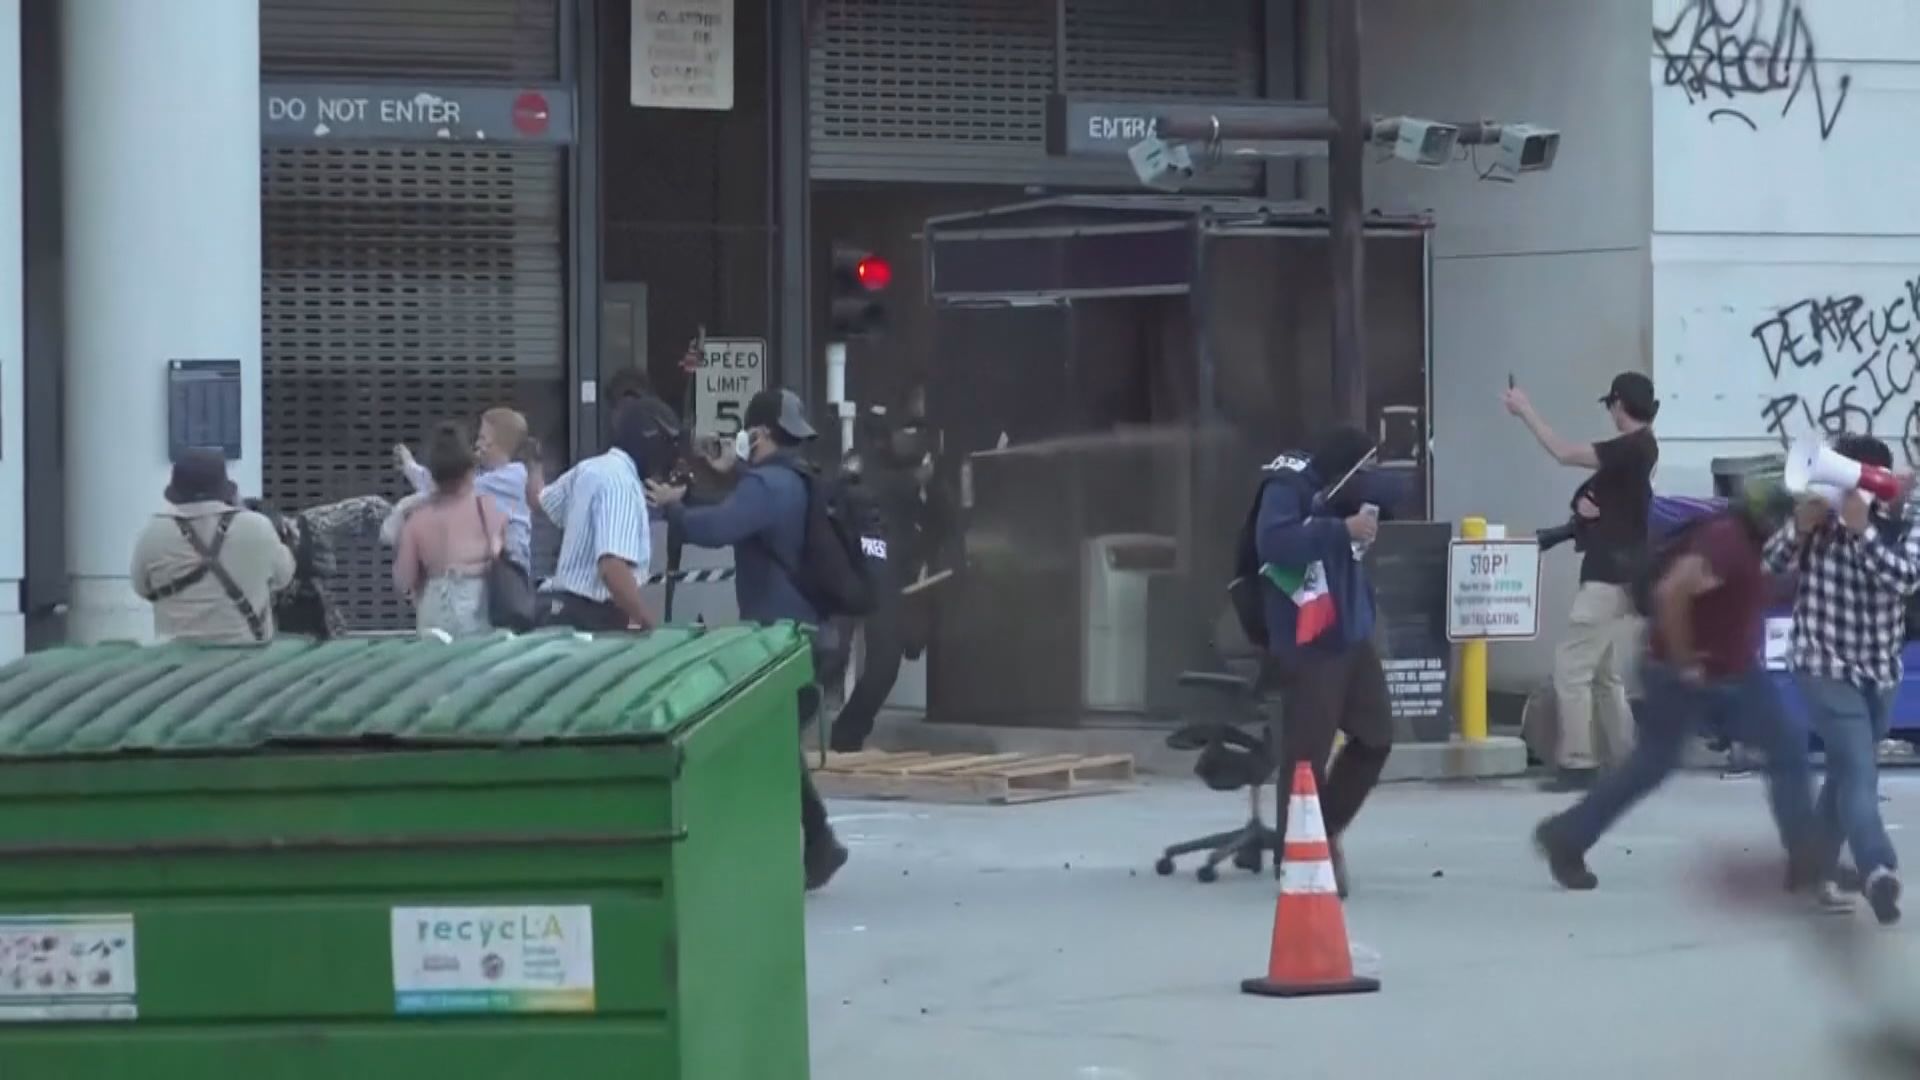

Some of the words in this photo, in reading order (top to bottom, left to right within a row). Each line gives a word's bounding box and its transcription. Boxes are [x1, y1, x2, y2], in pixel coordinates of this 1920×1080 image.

[268, 98, 306, 121] DO
[318, 97, 368, 122] NOT
[380, 99, 461, 123] ENTER
[703, 351, 759, 369] SPEED
[706, 375, 750, 393] LIMIT
[716, 401, 743, 438] 5
[1470, 553, 1508, 575] STOP!
